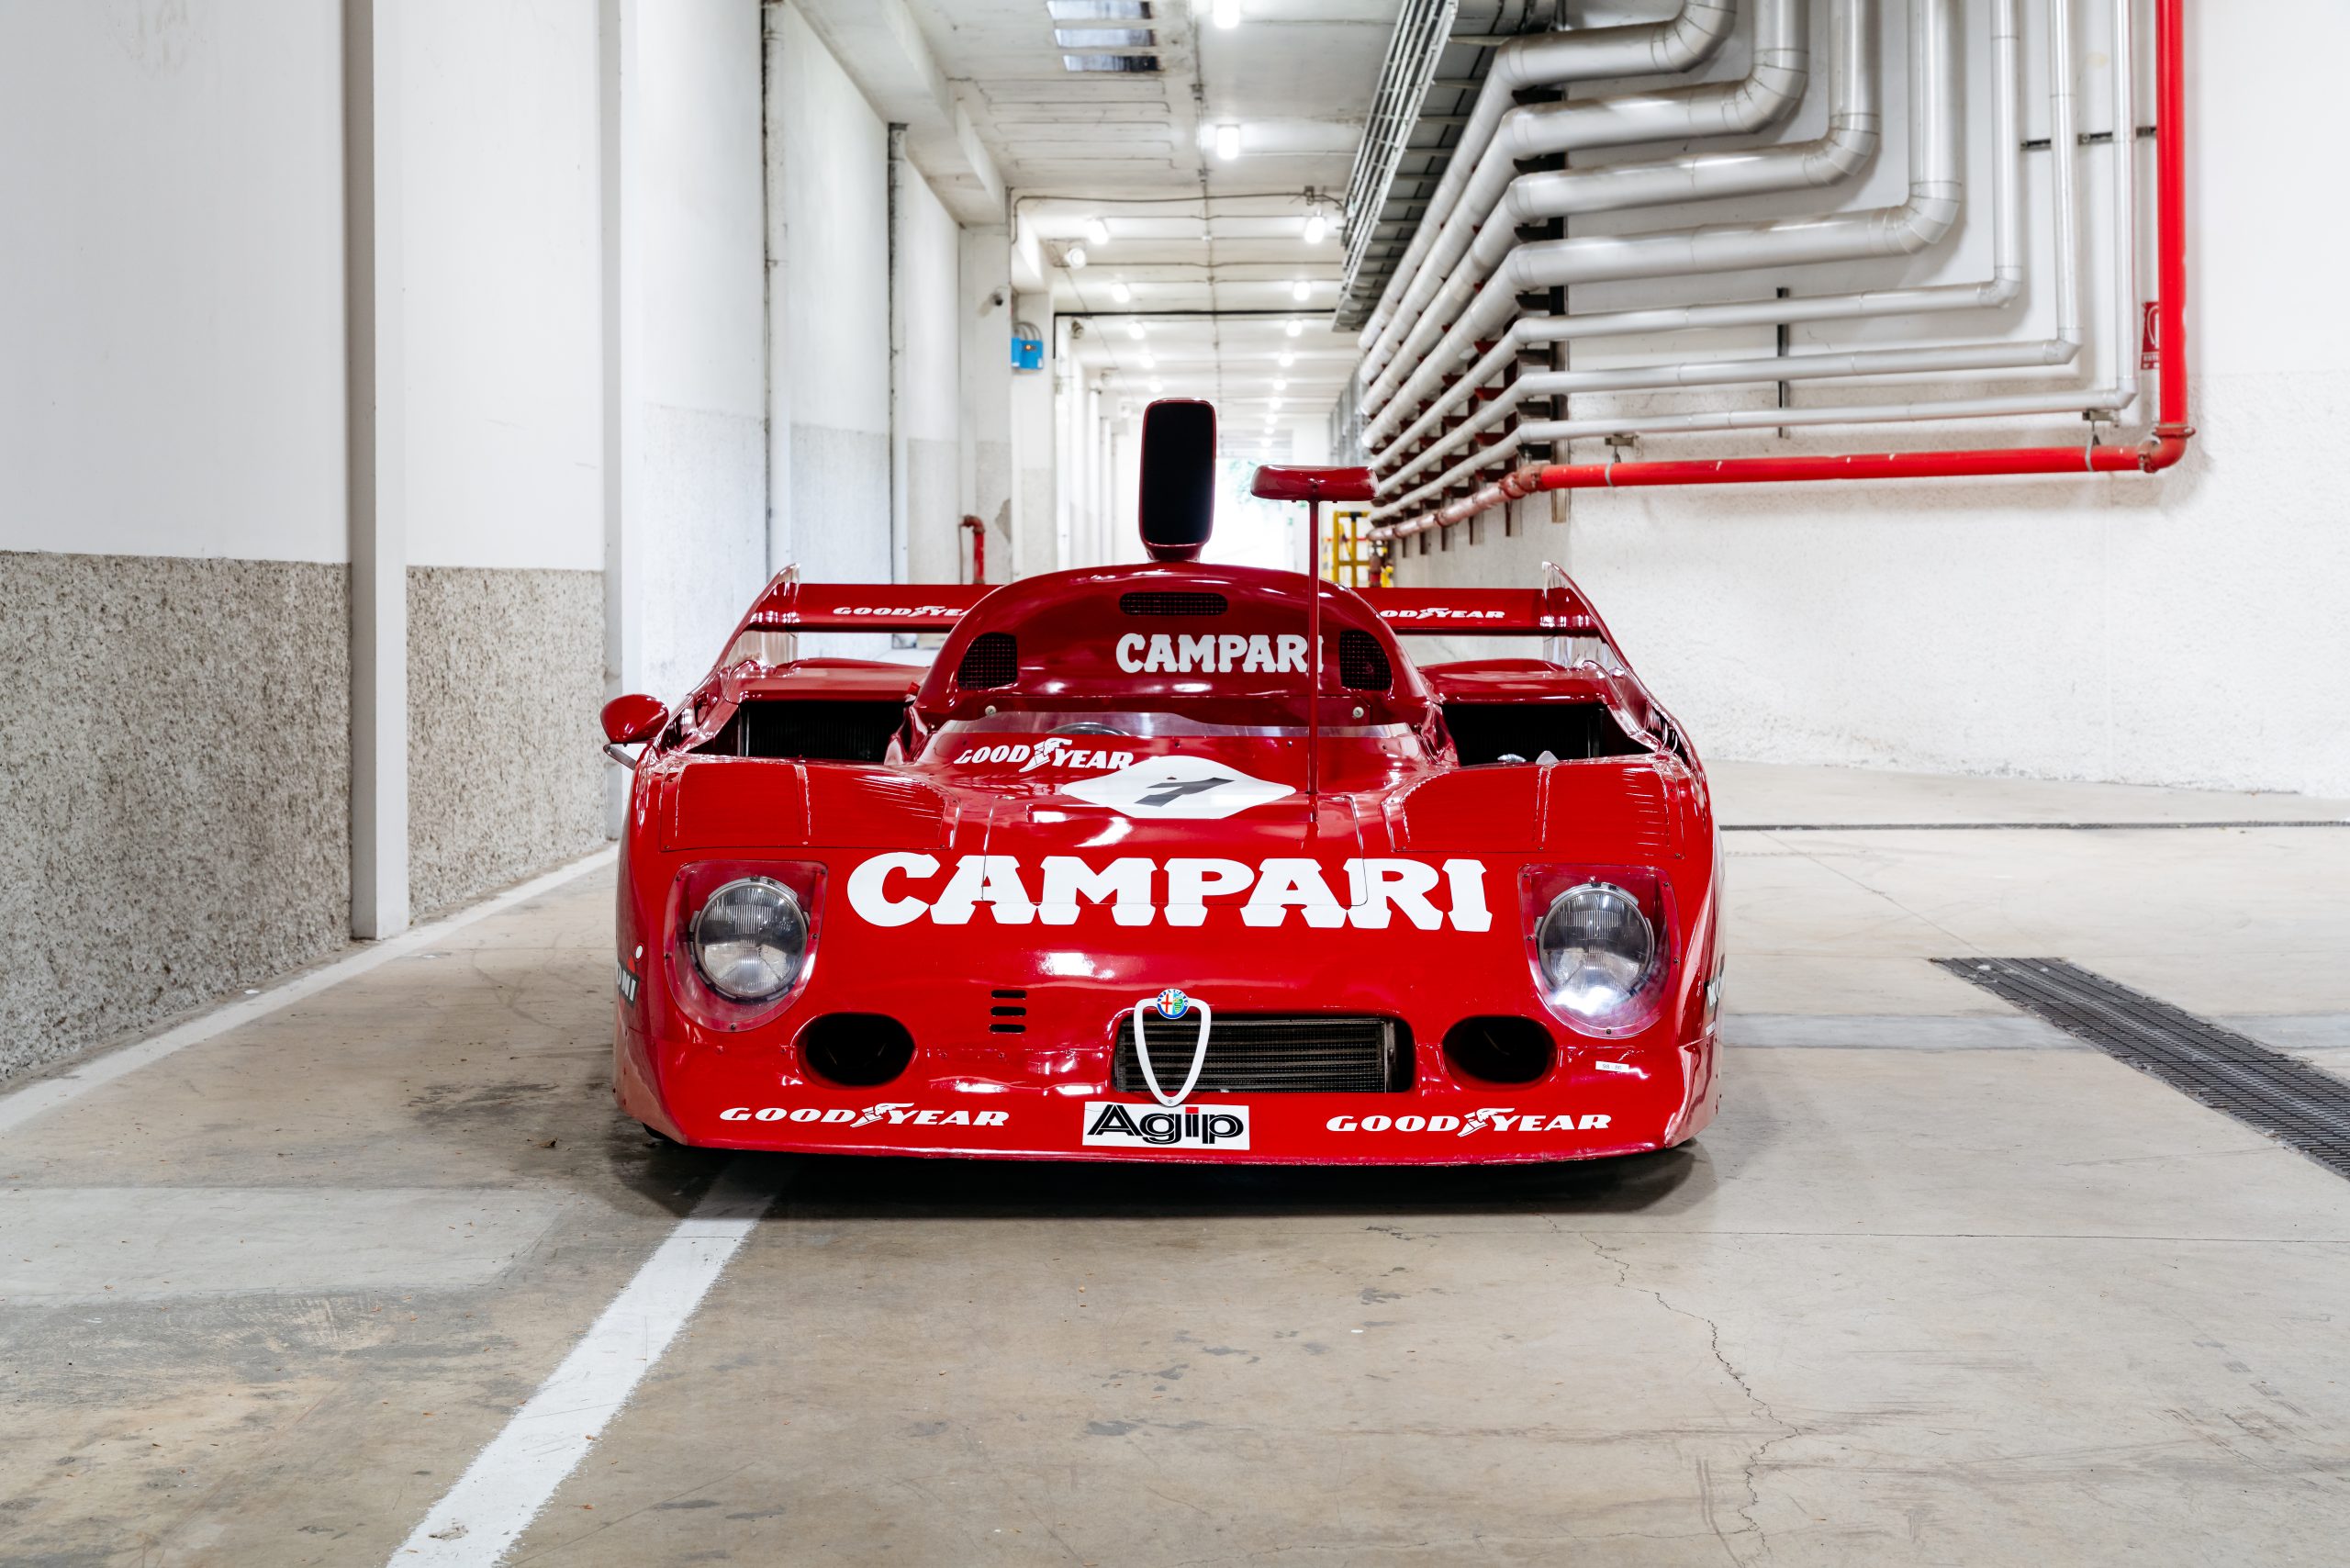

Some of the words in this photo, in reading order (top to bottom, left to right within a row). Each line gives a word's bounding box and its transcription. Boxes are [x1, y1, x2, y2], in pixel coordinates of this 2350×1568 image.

[846, 852, 1493, 932] CAMPARI
[720, 1103, 1009, 1126] GOODYEAR
[1087, 1103, 1244, 1145] Agip
[1326, 1109, 1611, 1135] GOODYEAR
